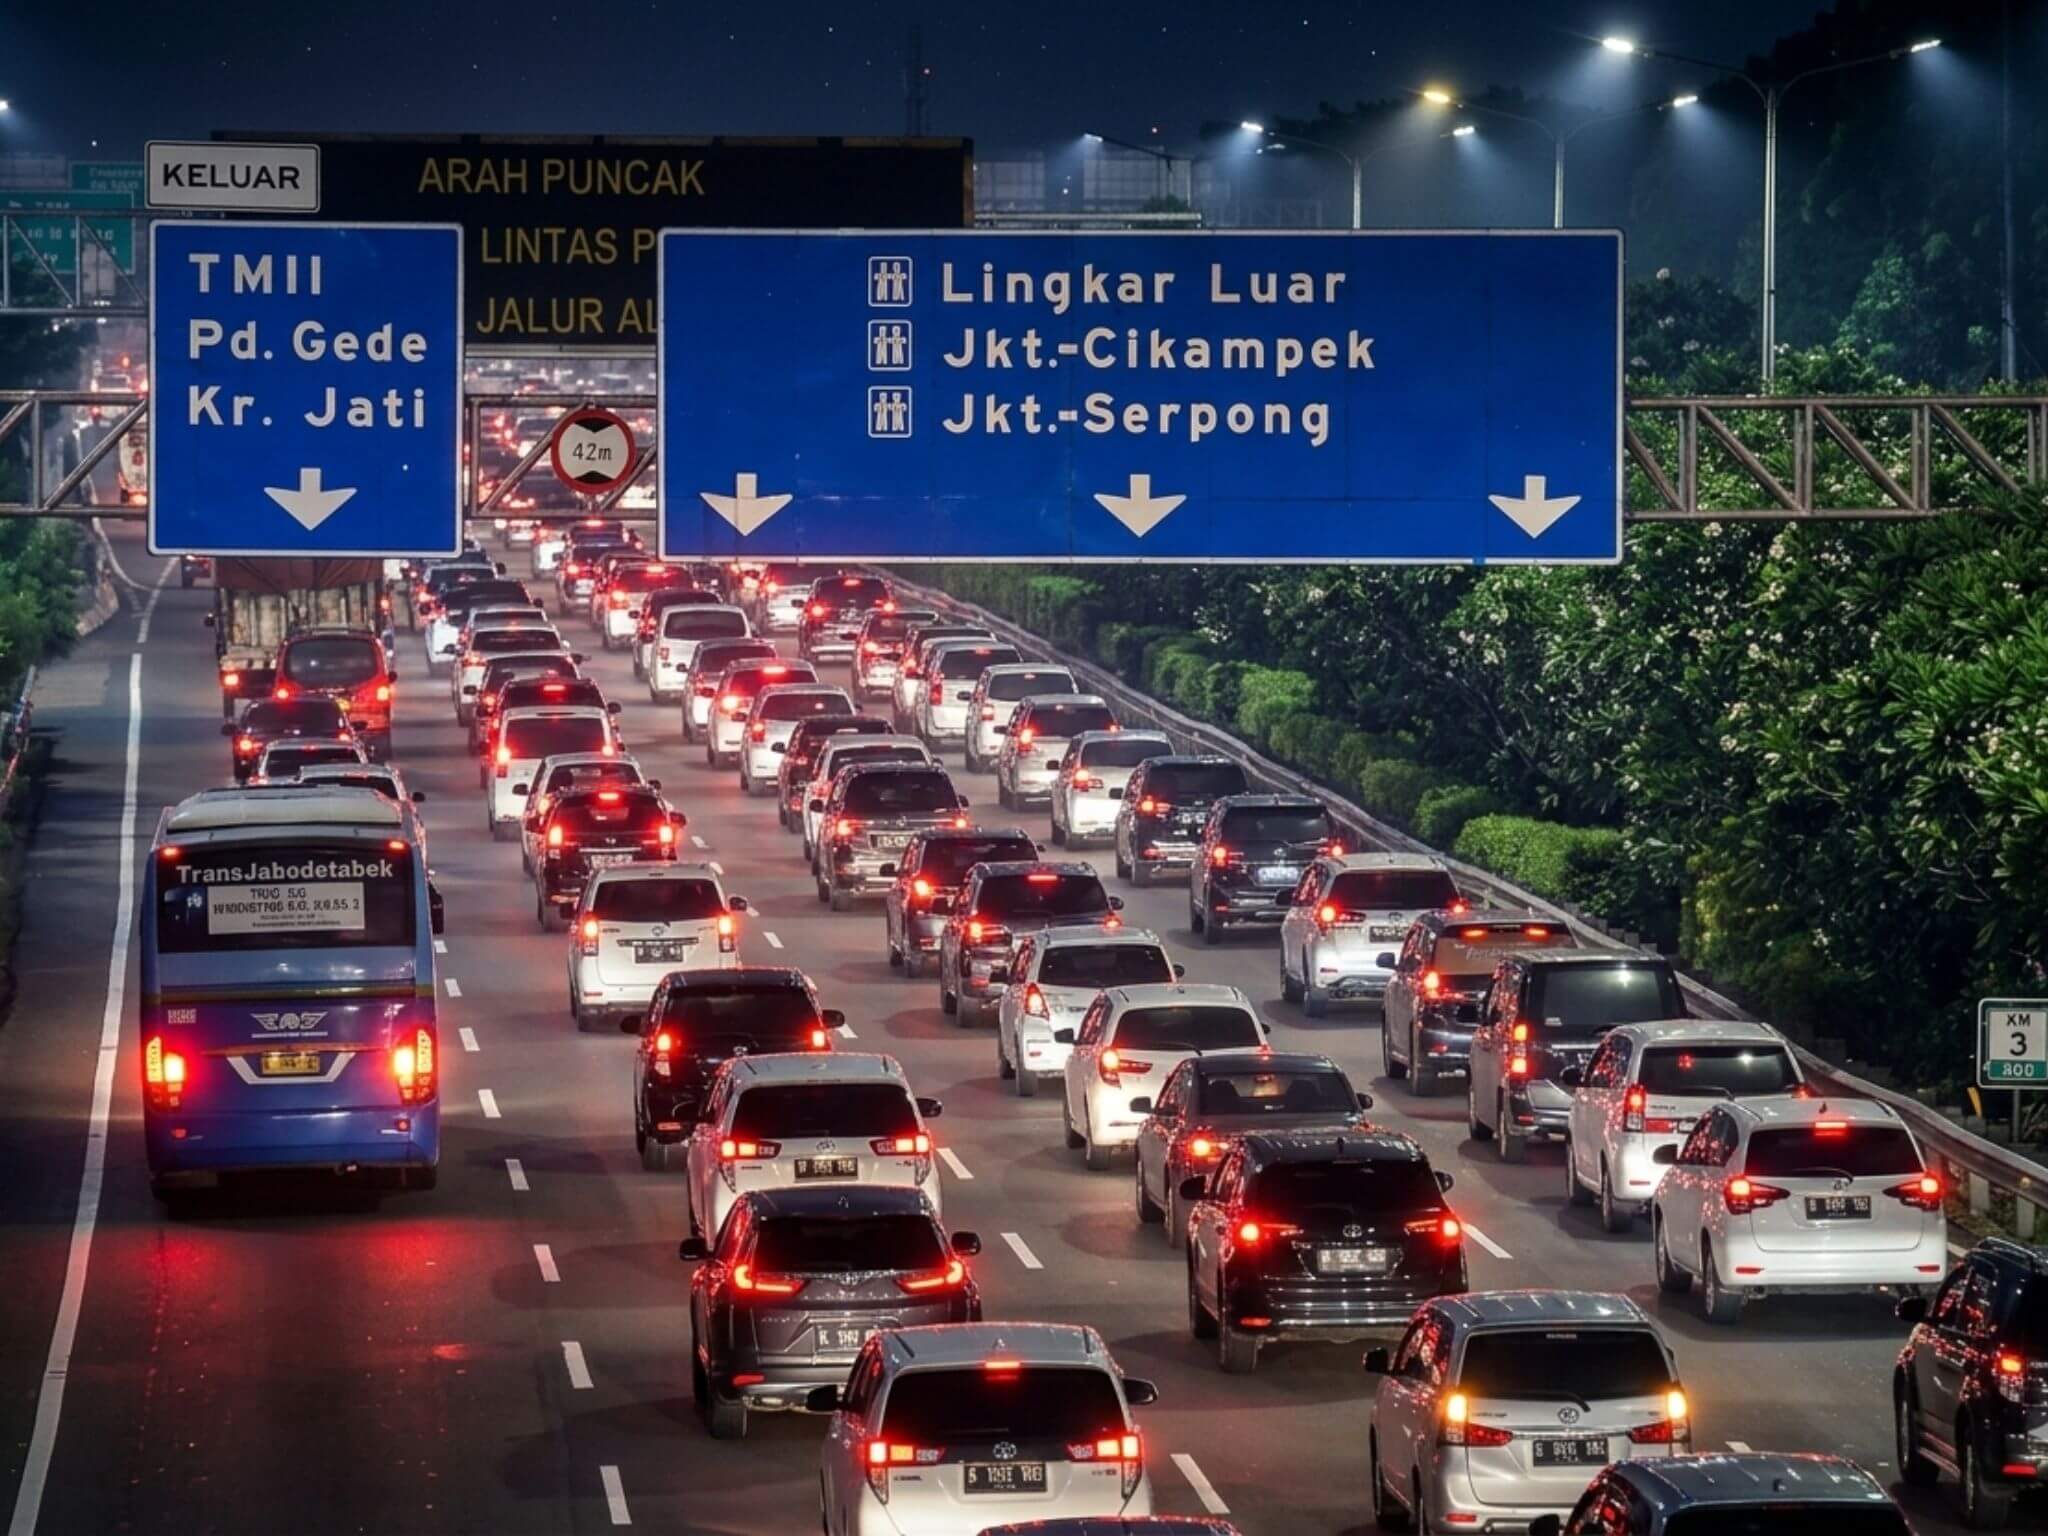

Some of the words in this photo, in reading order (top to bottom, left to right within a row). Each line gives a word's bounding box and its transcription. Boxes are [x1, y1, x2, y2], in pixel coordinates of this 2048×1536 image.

[162, 163, 300, 190] KELUAR
[418, 157, 528, 194] ARAH
[542, 158, 705, 195] PUNCAK
[481, 227, 617, 264] LINTAS
[189, 254, 321, 295] TMII
[942, 263, 1175, 314] Lingkar
[1210, 263, 1346, 304] Luar
[477, 297, 604, 334] JALUR
[189, 319, 274, 360] Pd.
[292, 320, 428, 362] Gede
[942, 327, 1376, 377] Jkt.-Cikampek
[189, 385, 273, 426] Kr.
[304, 387, 424, 428] Jati
[942, 392, 1330, 447] Jkt.-Serpong
[176, 859, 393, 884] TransJabodetabek
[2009, 1031, 2028, 1057] 3
